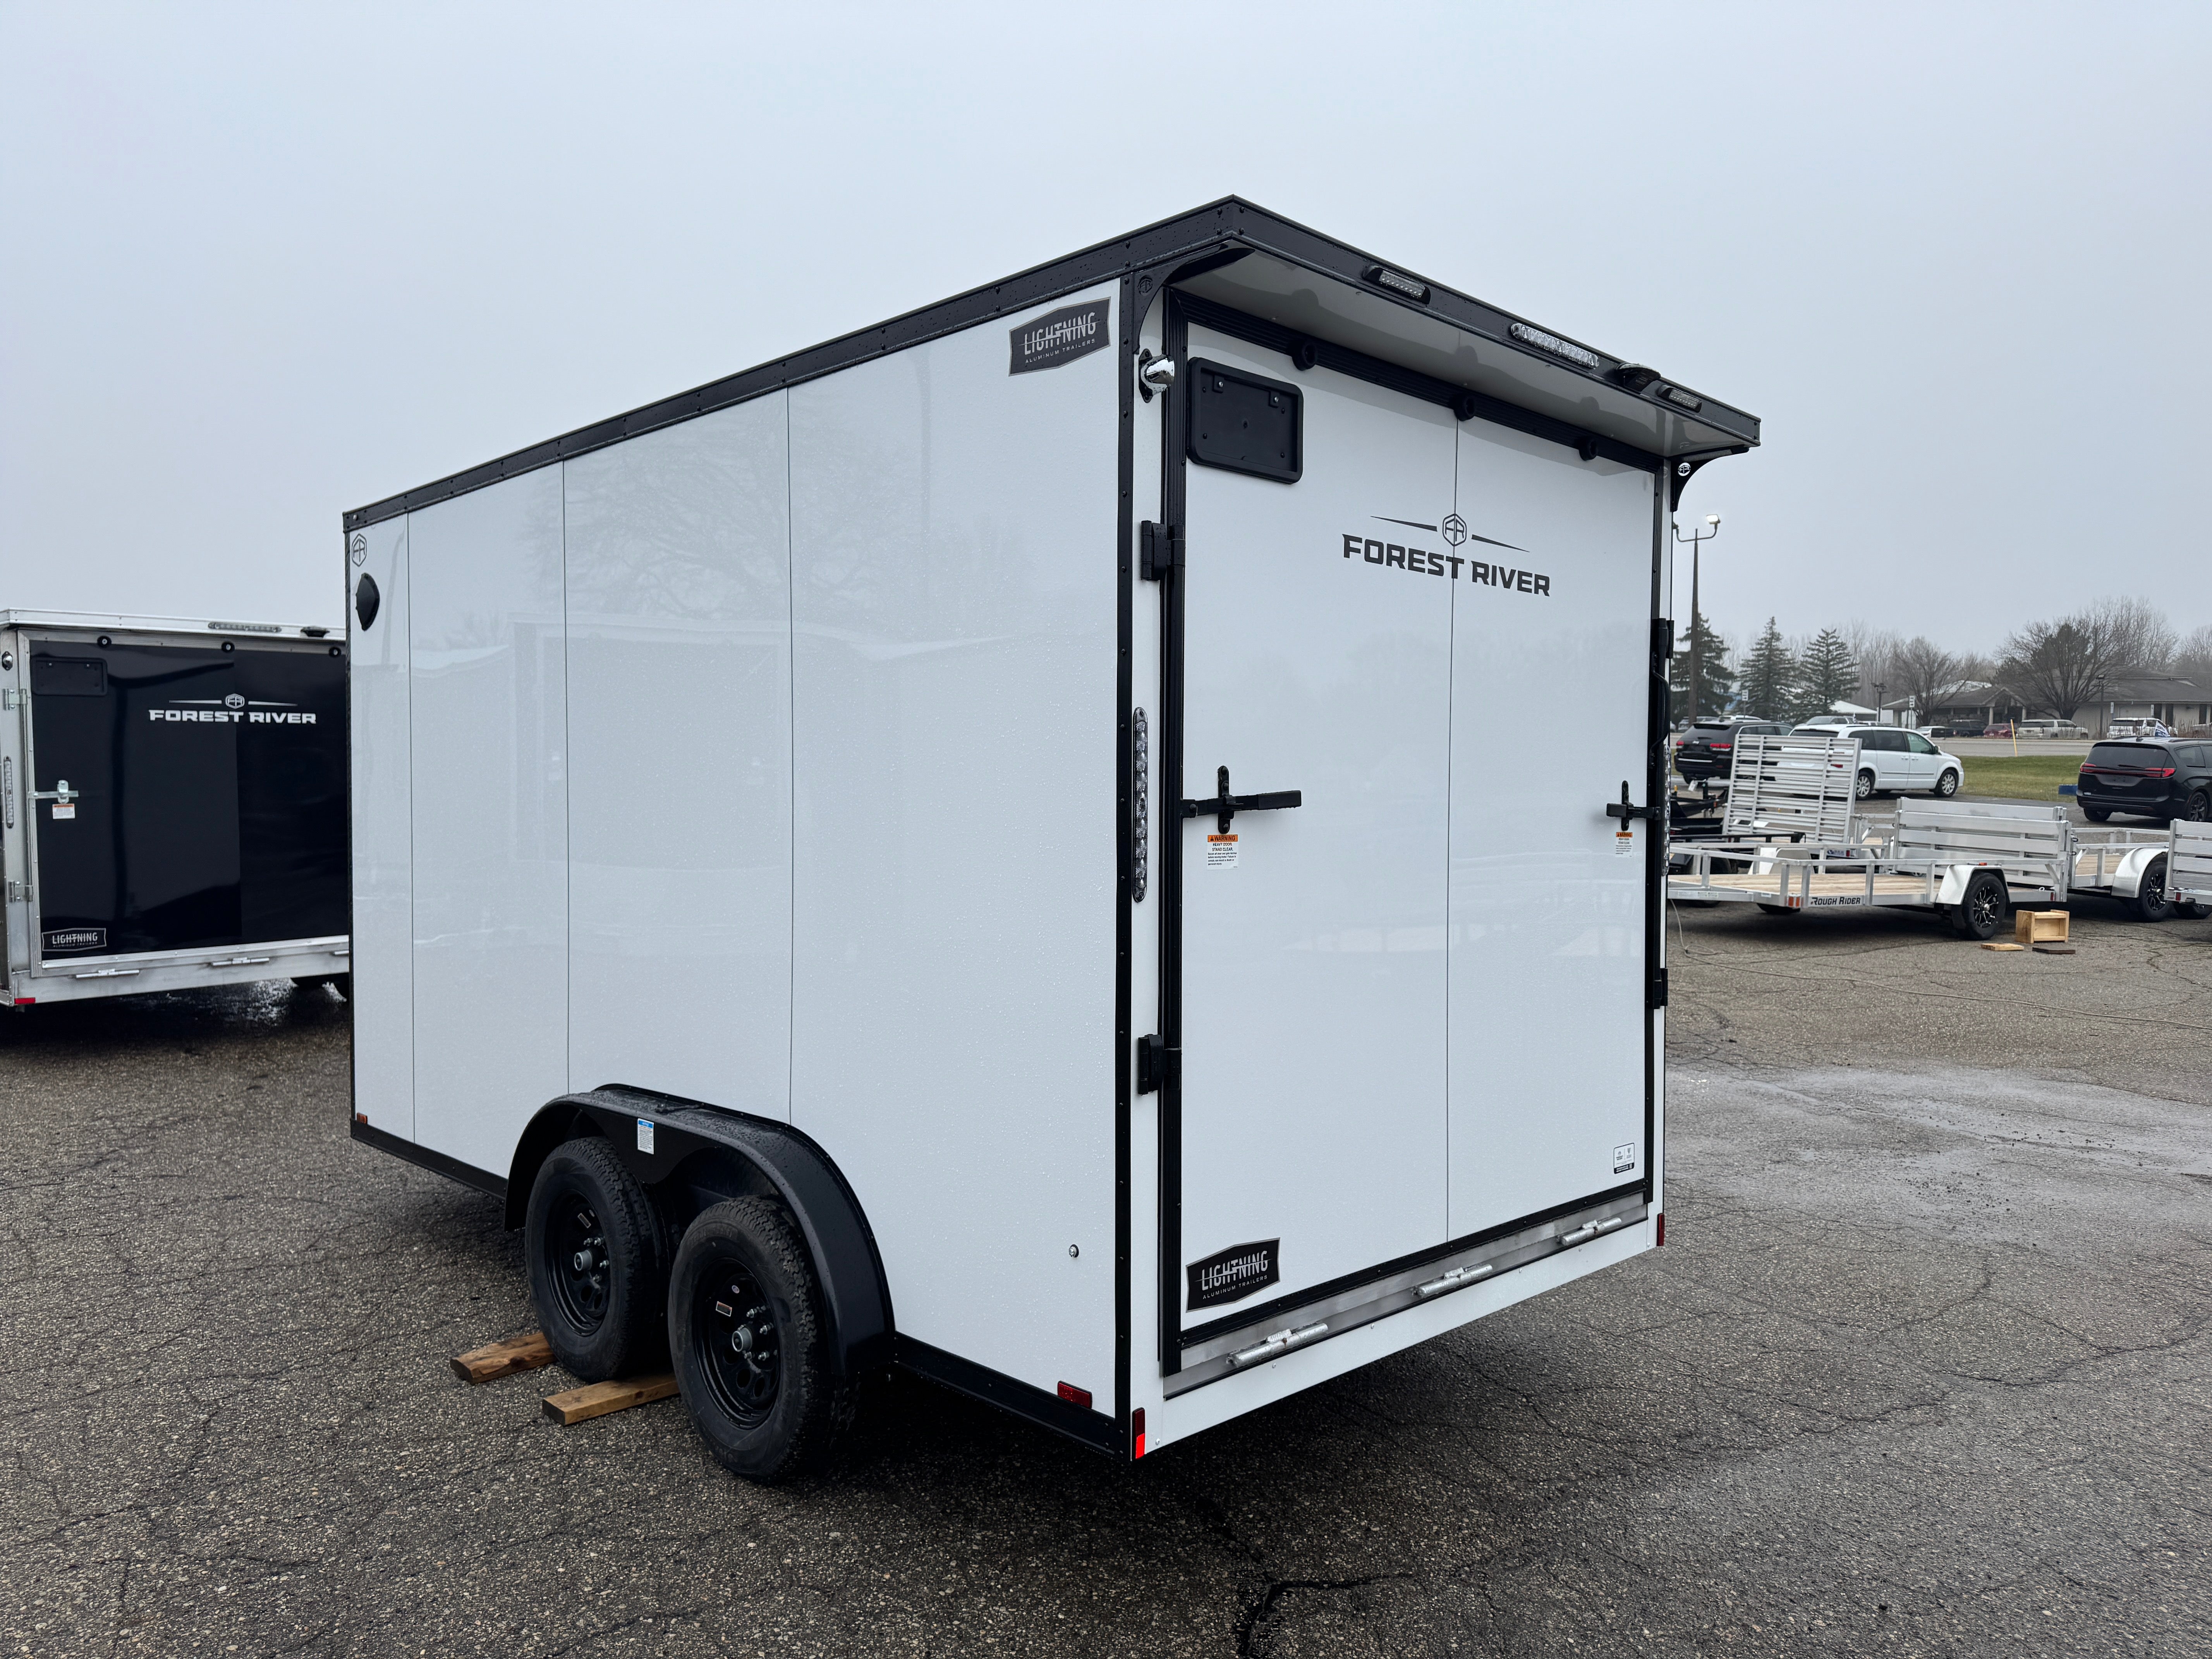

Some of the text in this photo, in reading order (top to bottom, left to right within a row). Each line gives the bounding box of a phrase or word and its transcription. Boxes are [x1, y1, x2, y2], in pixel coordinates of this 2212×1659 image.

[1024, 312, 1097, 356] LIGHTNING
[1025, 338, 1096, 364] ALUMINUM TRAILERS
[1342, 533, 1550, 597] FOREST RIVER
[148, 709, 316, 724] FOREST RIVER
[1812, 896, 1861, 905] ROUGH RIDER
[52, 932, 98, 944] LIGHTNING
[1202, 1250, 1269, 1291] LIGHTNING
[1203, 1274, 1268, 1300] ALUMINUM TRAILERS
